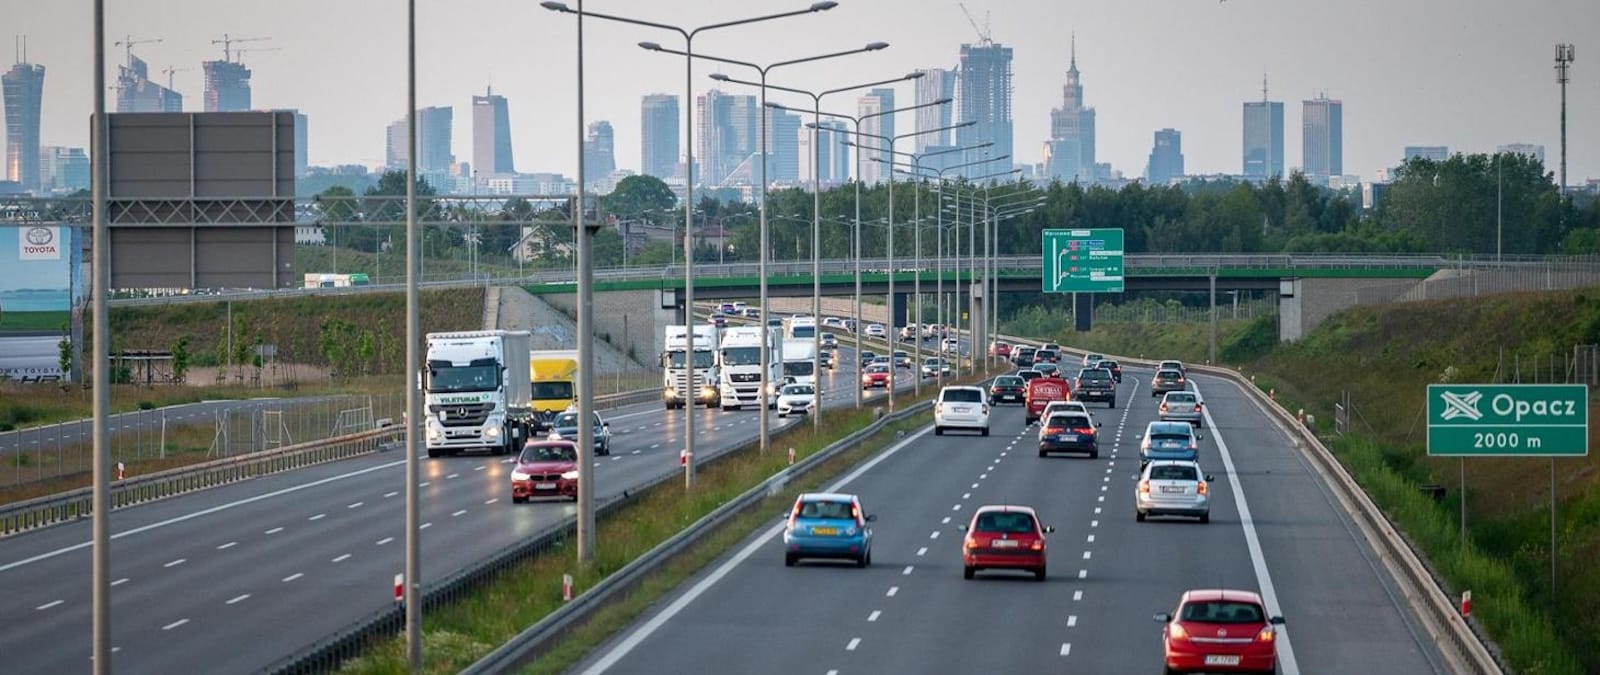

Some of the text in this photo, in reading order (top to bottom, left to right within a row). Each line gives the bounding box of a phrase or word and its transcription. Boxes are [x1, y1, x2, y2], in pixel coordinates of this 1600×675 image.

[1492, 393, 1575, 422] Opacz
[1474, 433, 1541, 448] 2000 m
